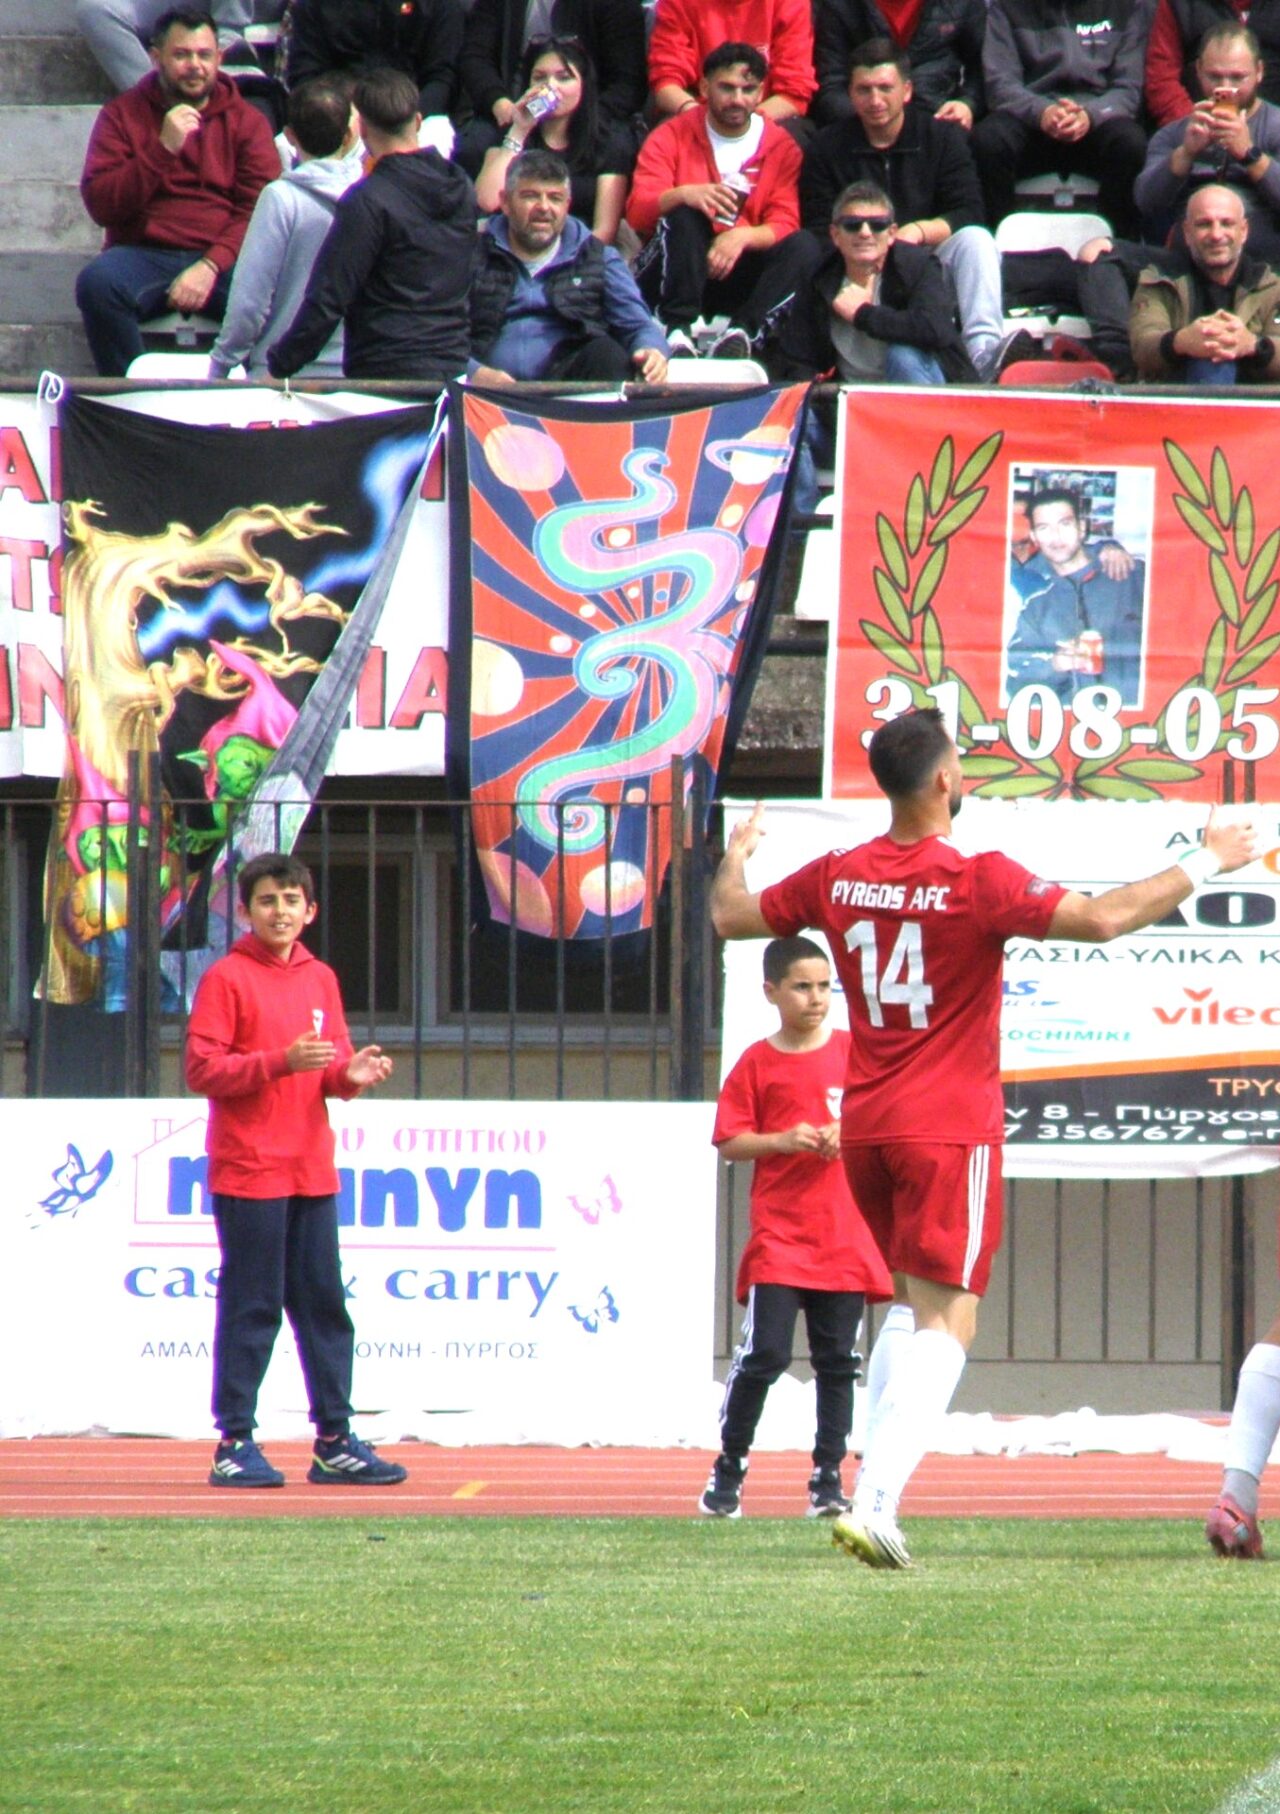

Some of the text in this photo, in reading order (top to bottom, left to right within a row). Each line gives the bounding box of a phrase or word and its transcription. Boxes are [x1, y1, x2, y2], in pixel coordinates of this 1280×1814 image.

[861, 678, 1280, 761] 31-08-05
[831, 880, 950, 911] PYRGOS AFC
[844, 920, 934, 1029] 14
[1042, 1104, 1069, 1120] 8
[123, 1266, 219, 1298] cas
[385, 1268, 559, 1318] carry
[445, 1342, 539, 1359] ΠΥΡΓΟΣ
